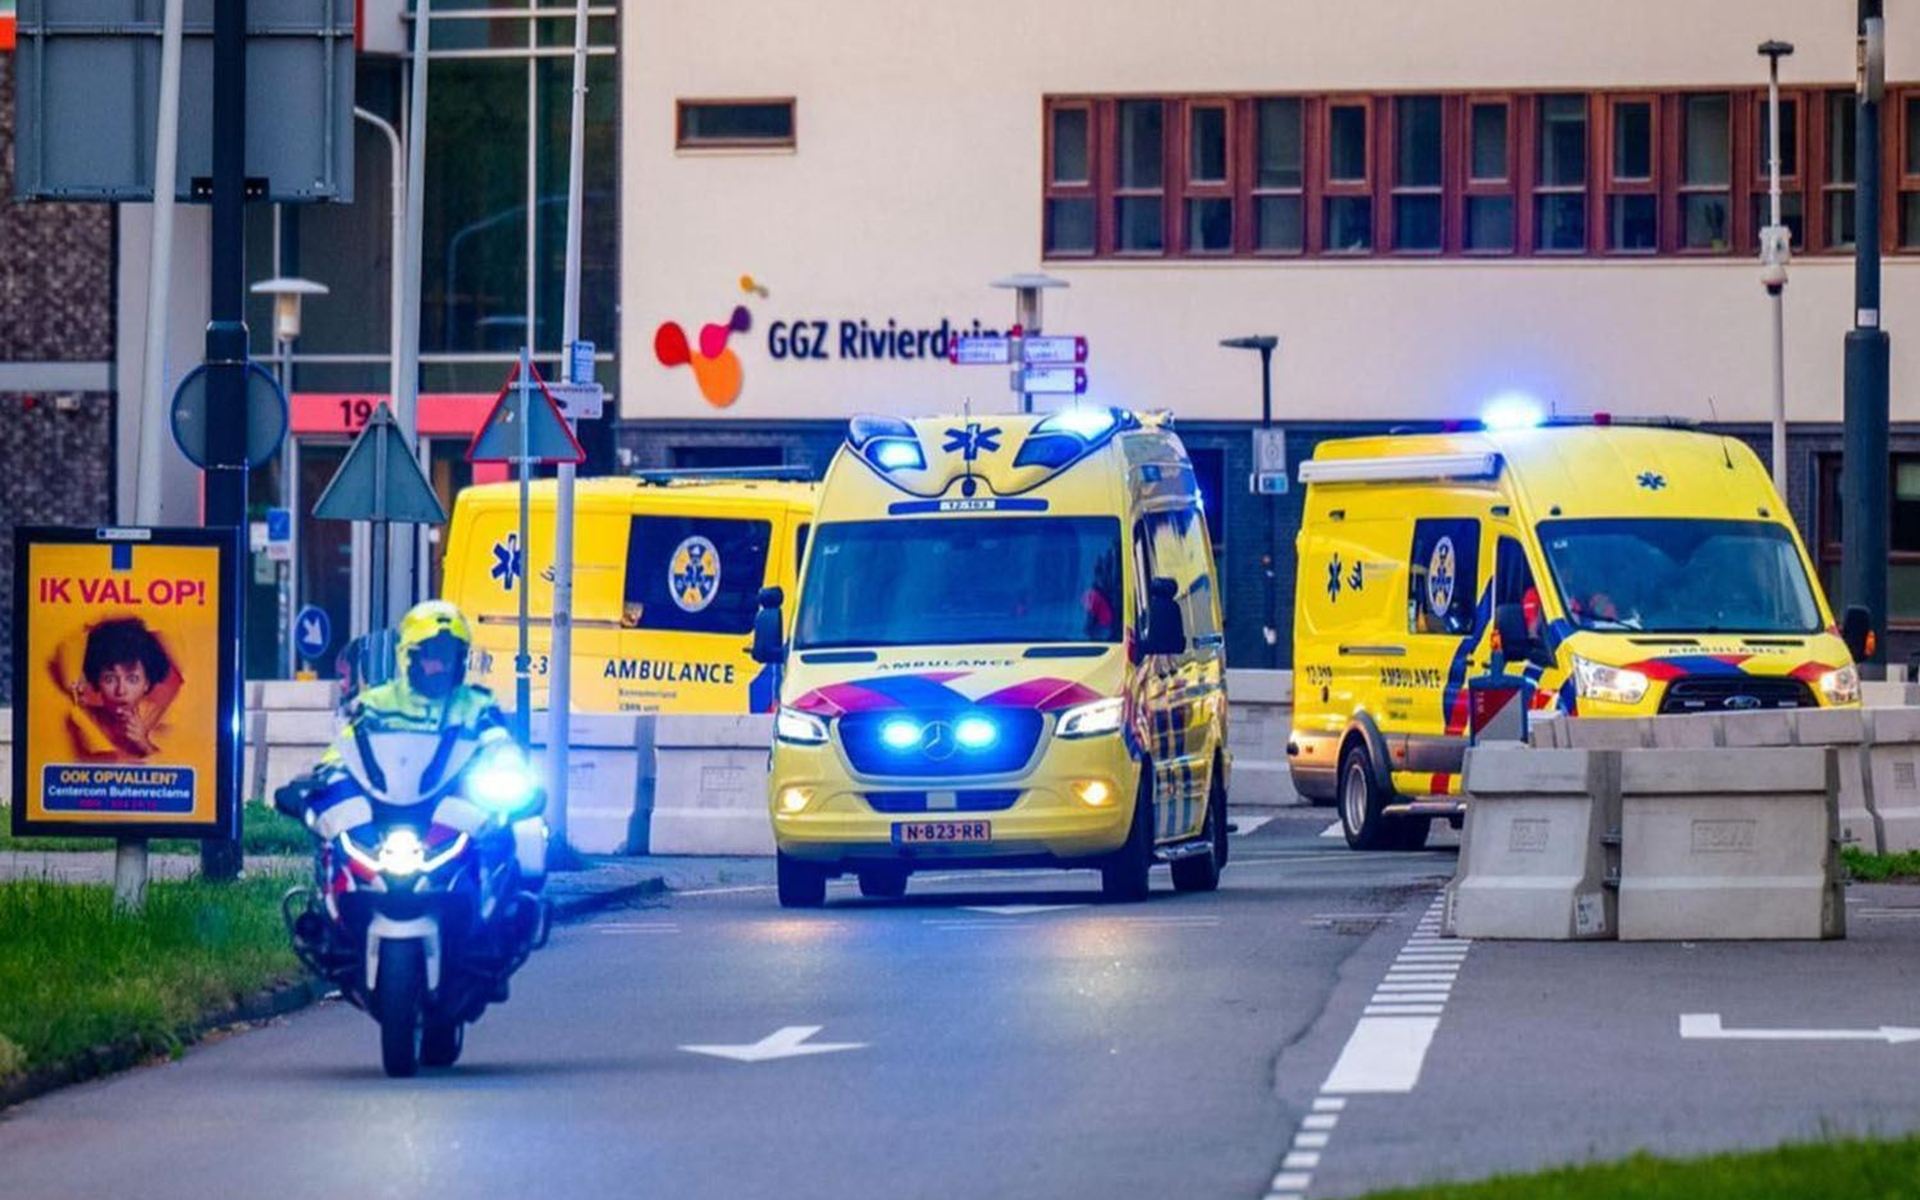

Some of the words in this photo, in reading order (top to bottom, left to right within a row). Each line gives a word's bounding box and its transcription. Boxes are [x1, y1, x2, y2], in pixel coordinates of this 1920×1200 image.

[768, 320, 829, 360] GGZ
[340, 399, 372, 427] 19
[40, 578, 71, 604] IK
[78, 578, 142, 604] VAL
[147, 579, 205, 605] OP!
[603, 659, 735, 684] AMBULANCE
[876, 658, 1015, 671] AMBULANCE
[1380, 667, 1441, 688] AMBULANCE
[60, 769, 90, 784] OOK
[109, 785, 190, 799] Buitenreclame
[906, 823, 985, 840] N-823-RR
